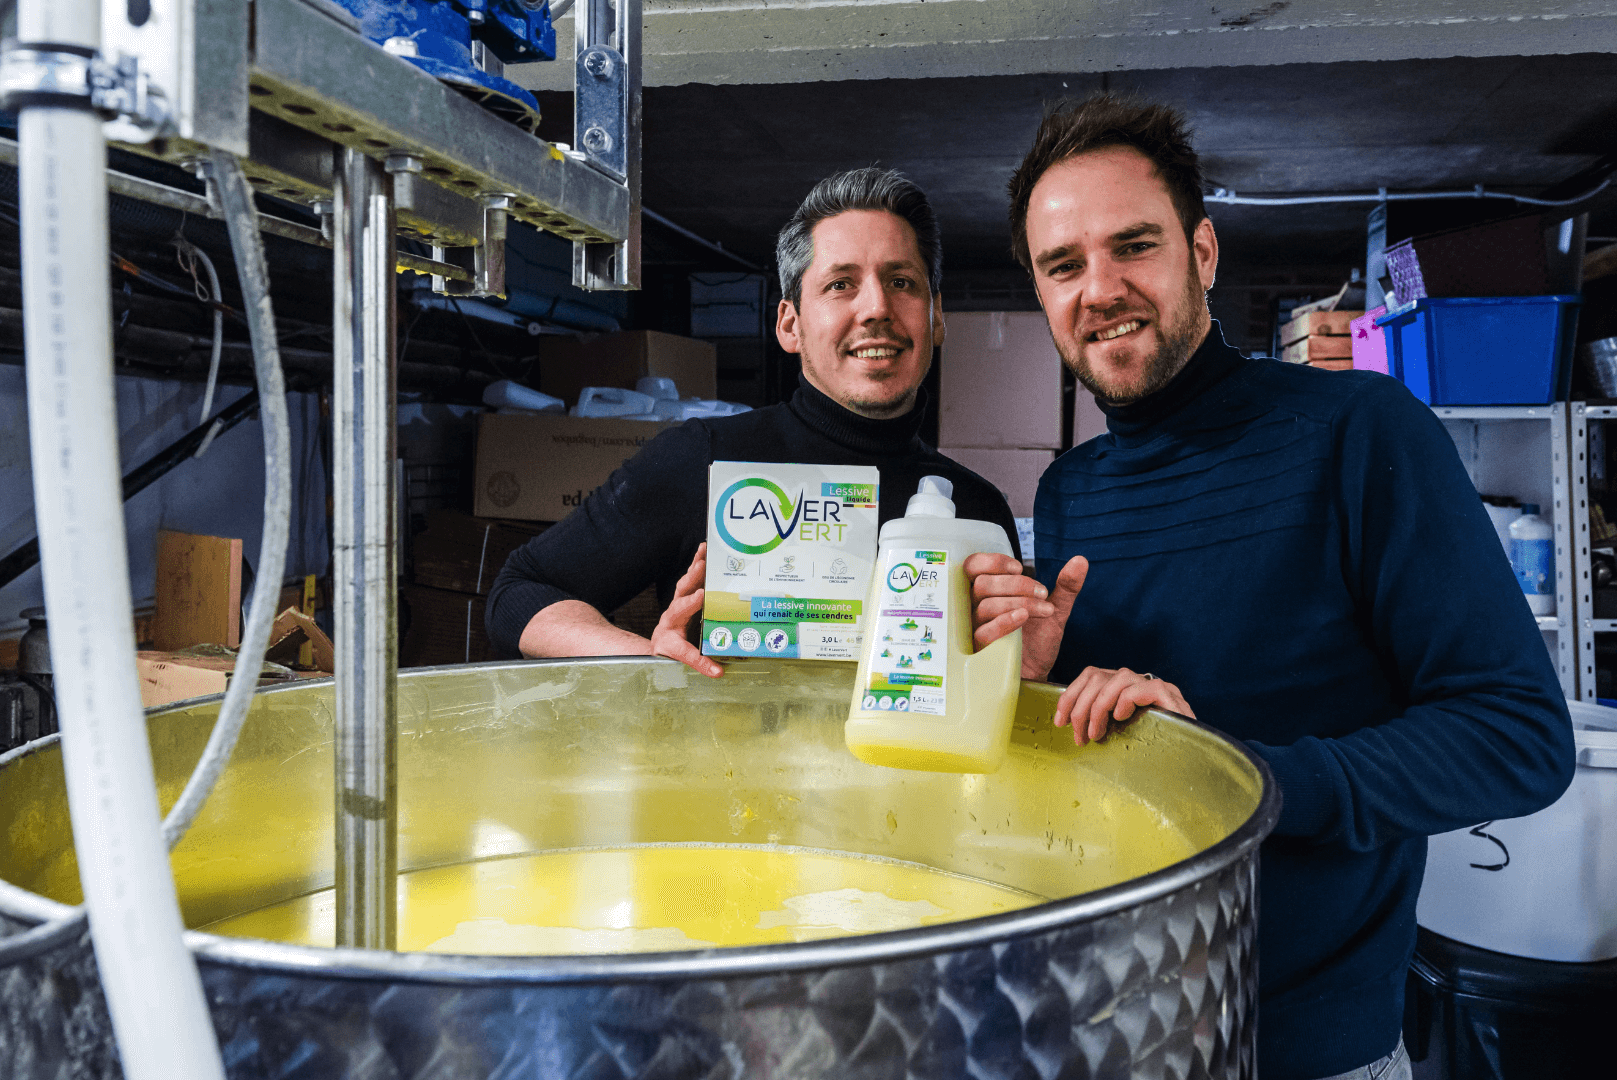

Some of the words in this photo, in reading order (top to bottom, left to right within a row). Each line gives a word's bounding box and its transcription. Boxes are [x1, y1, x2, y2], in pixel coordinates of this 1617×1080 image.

[829, 485, 870, 497] Lessive
[729, 488, 841, 541] LAVER
[892, 566, 938, 587] LAVER
[761, 600, 772, 609] La
[774, 600, 804, 610] lessive
[806, 602, 852, 611] innovante
[753, 609, 767, 619] qui
[794, 610, 805, 618] de
[821, 612, 853, 620] cendres
[821, 636, 833, 644] 3,0
